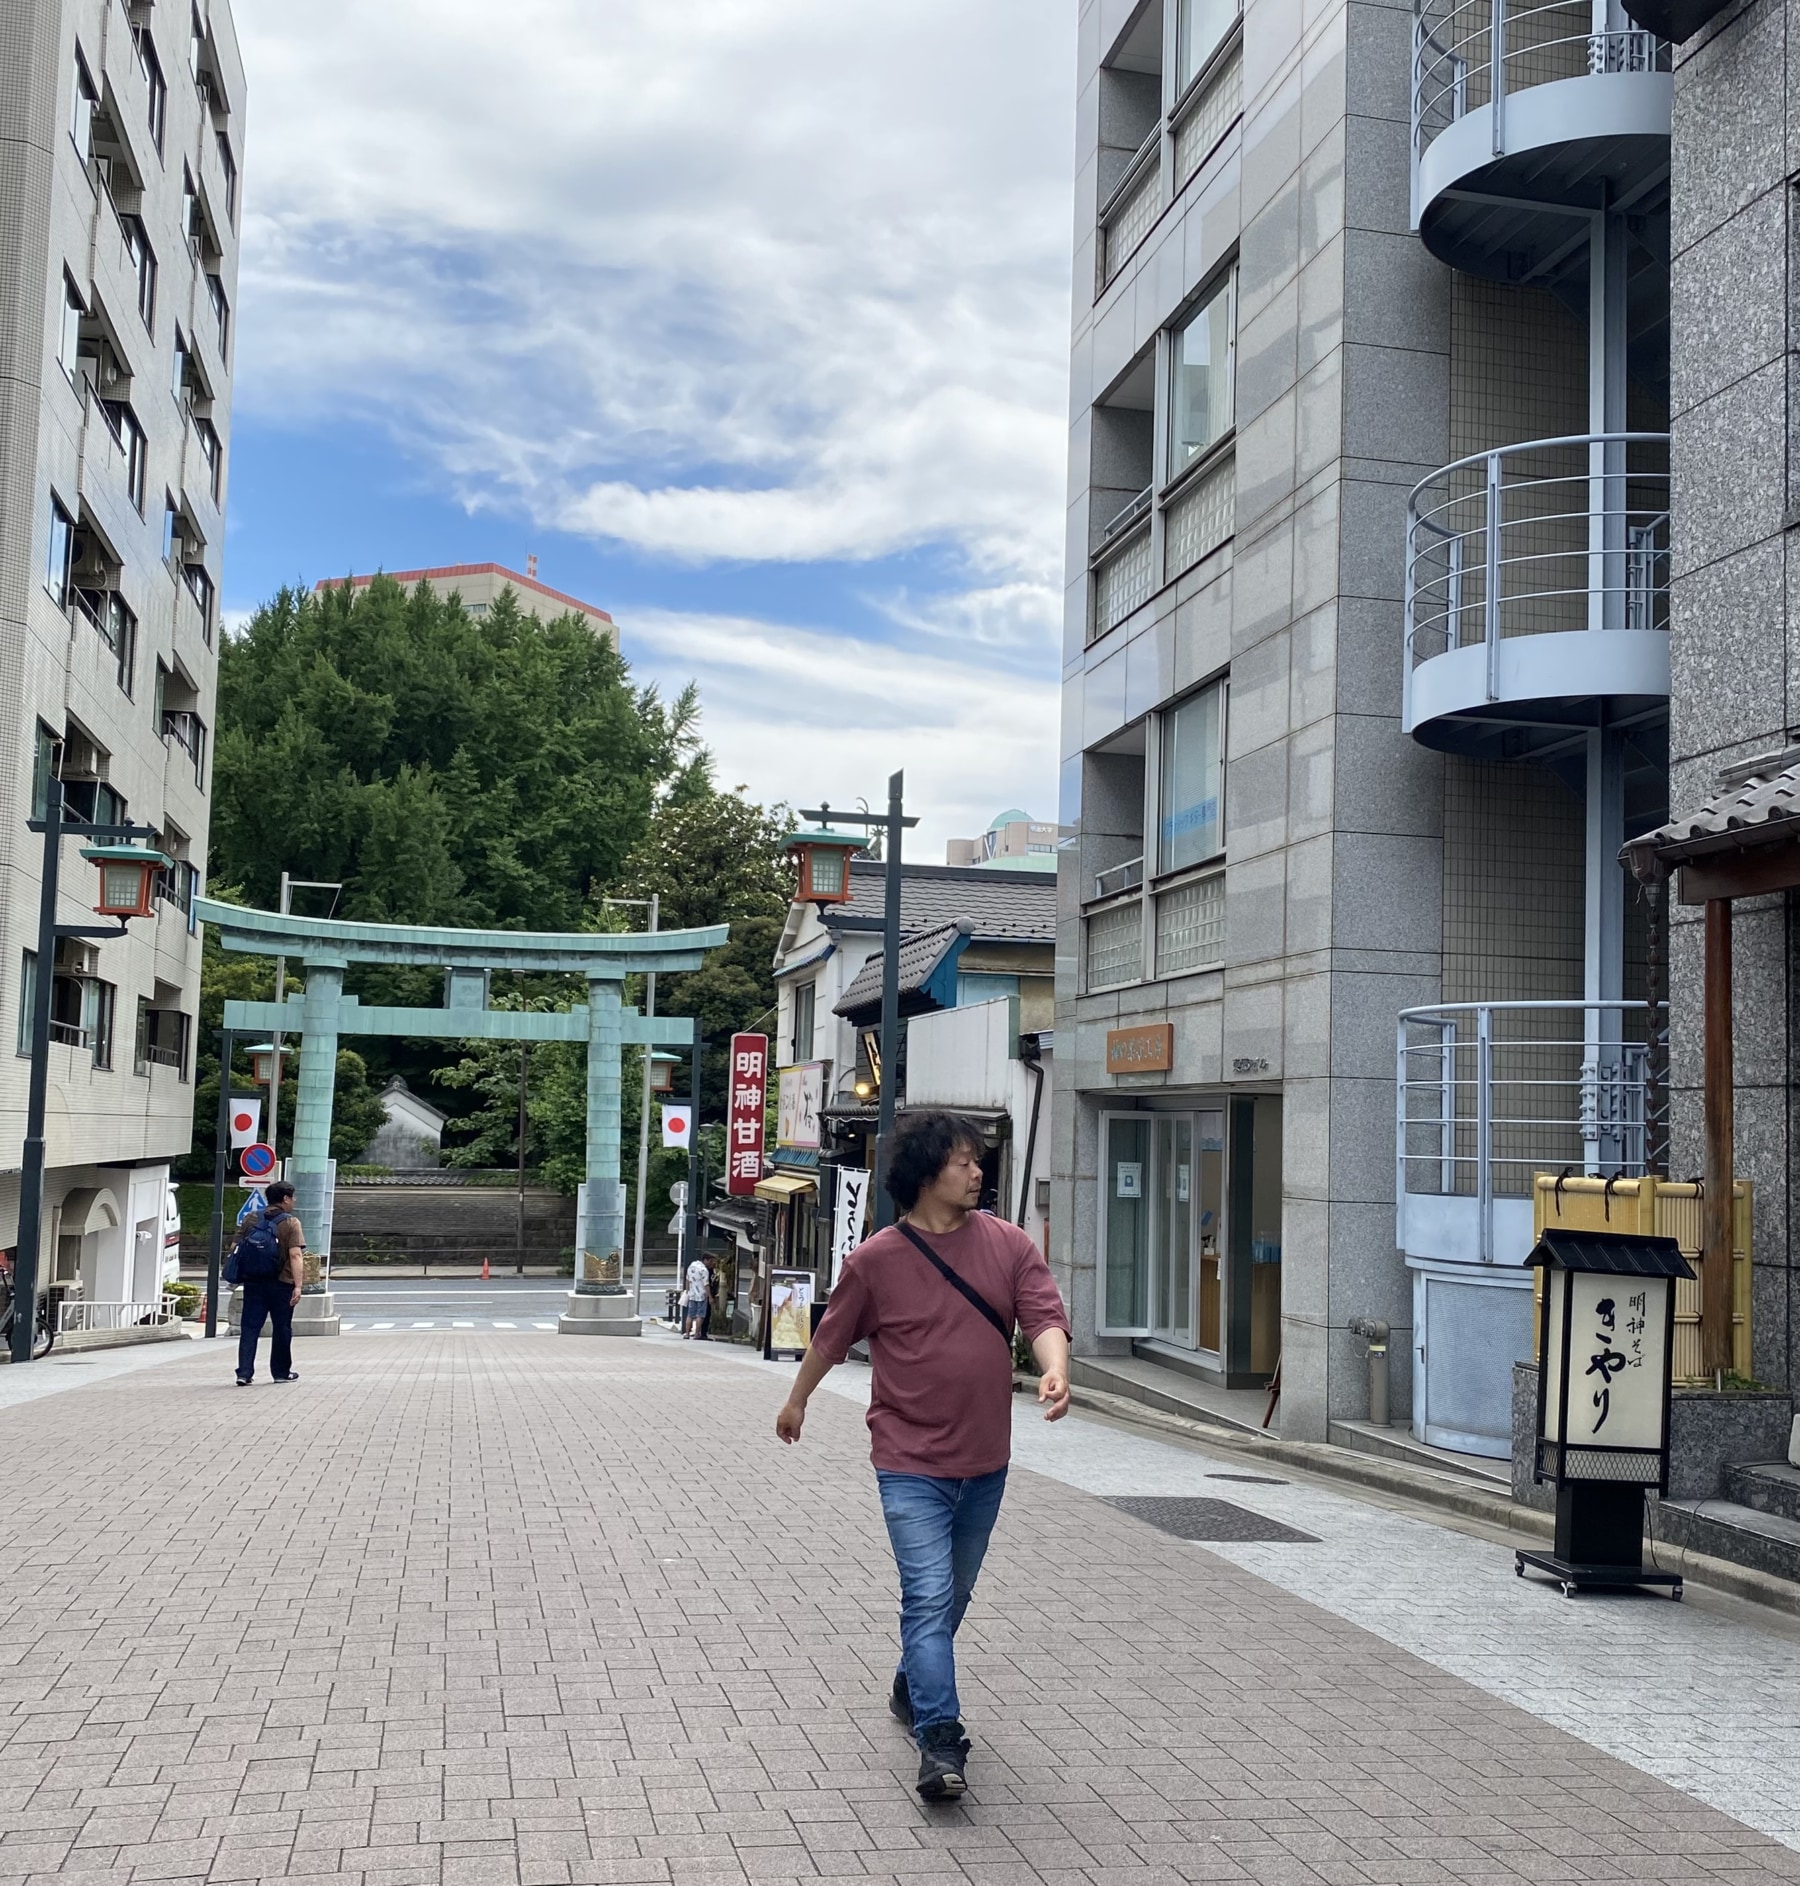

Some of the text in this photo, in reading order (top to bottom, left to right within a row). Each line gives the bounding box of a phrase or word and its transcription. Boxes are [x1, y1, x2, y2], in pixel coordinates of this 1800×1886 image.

[732, 1051, 763, 1178] 明神甘酒
[1585, 1298, 1626, 1434] きやり
[1626, 1291, 1646, 1368] 明神そば
